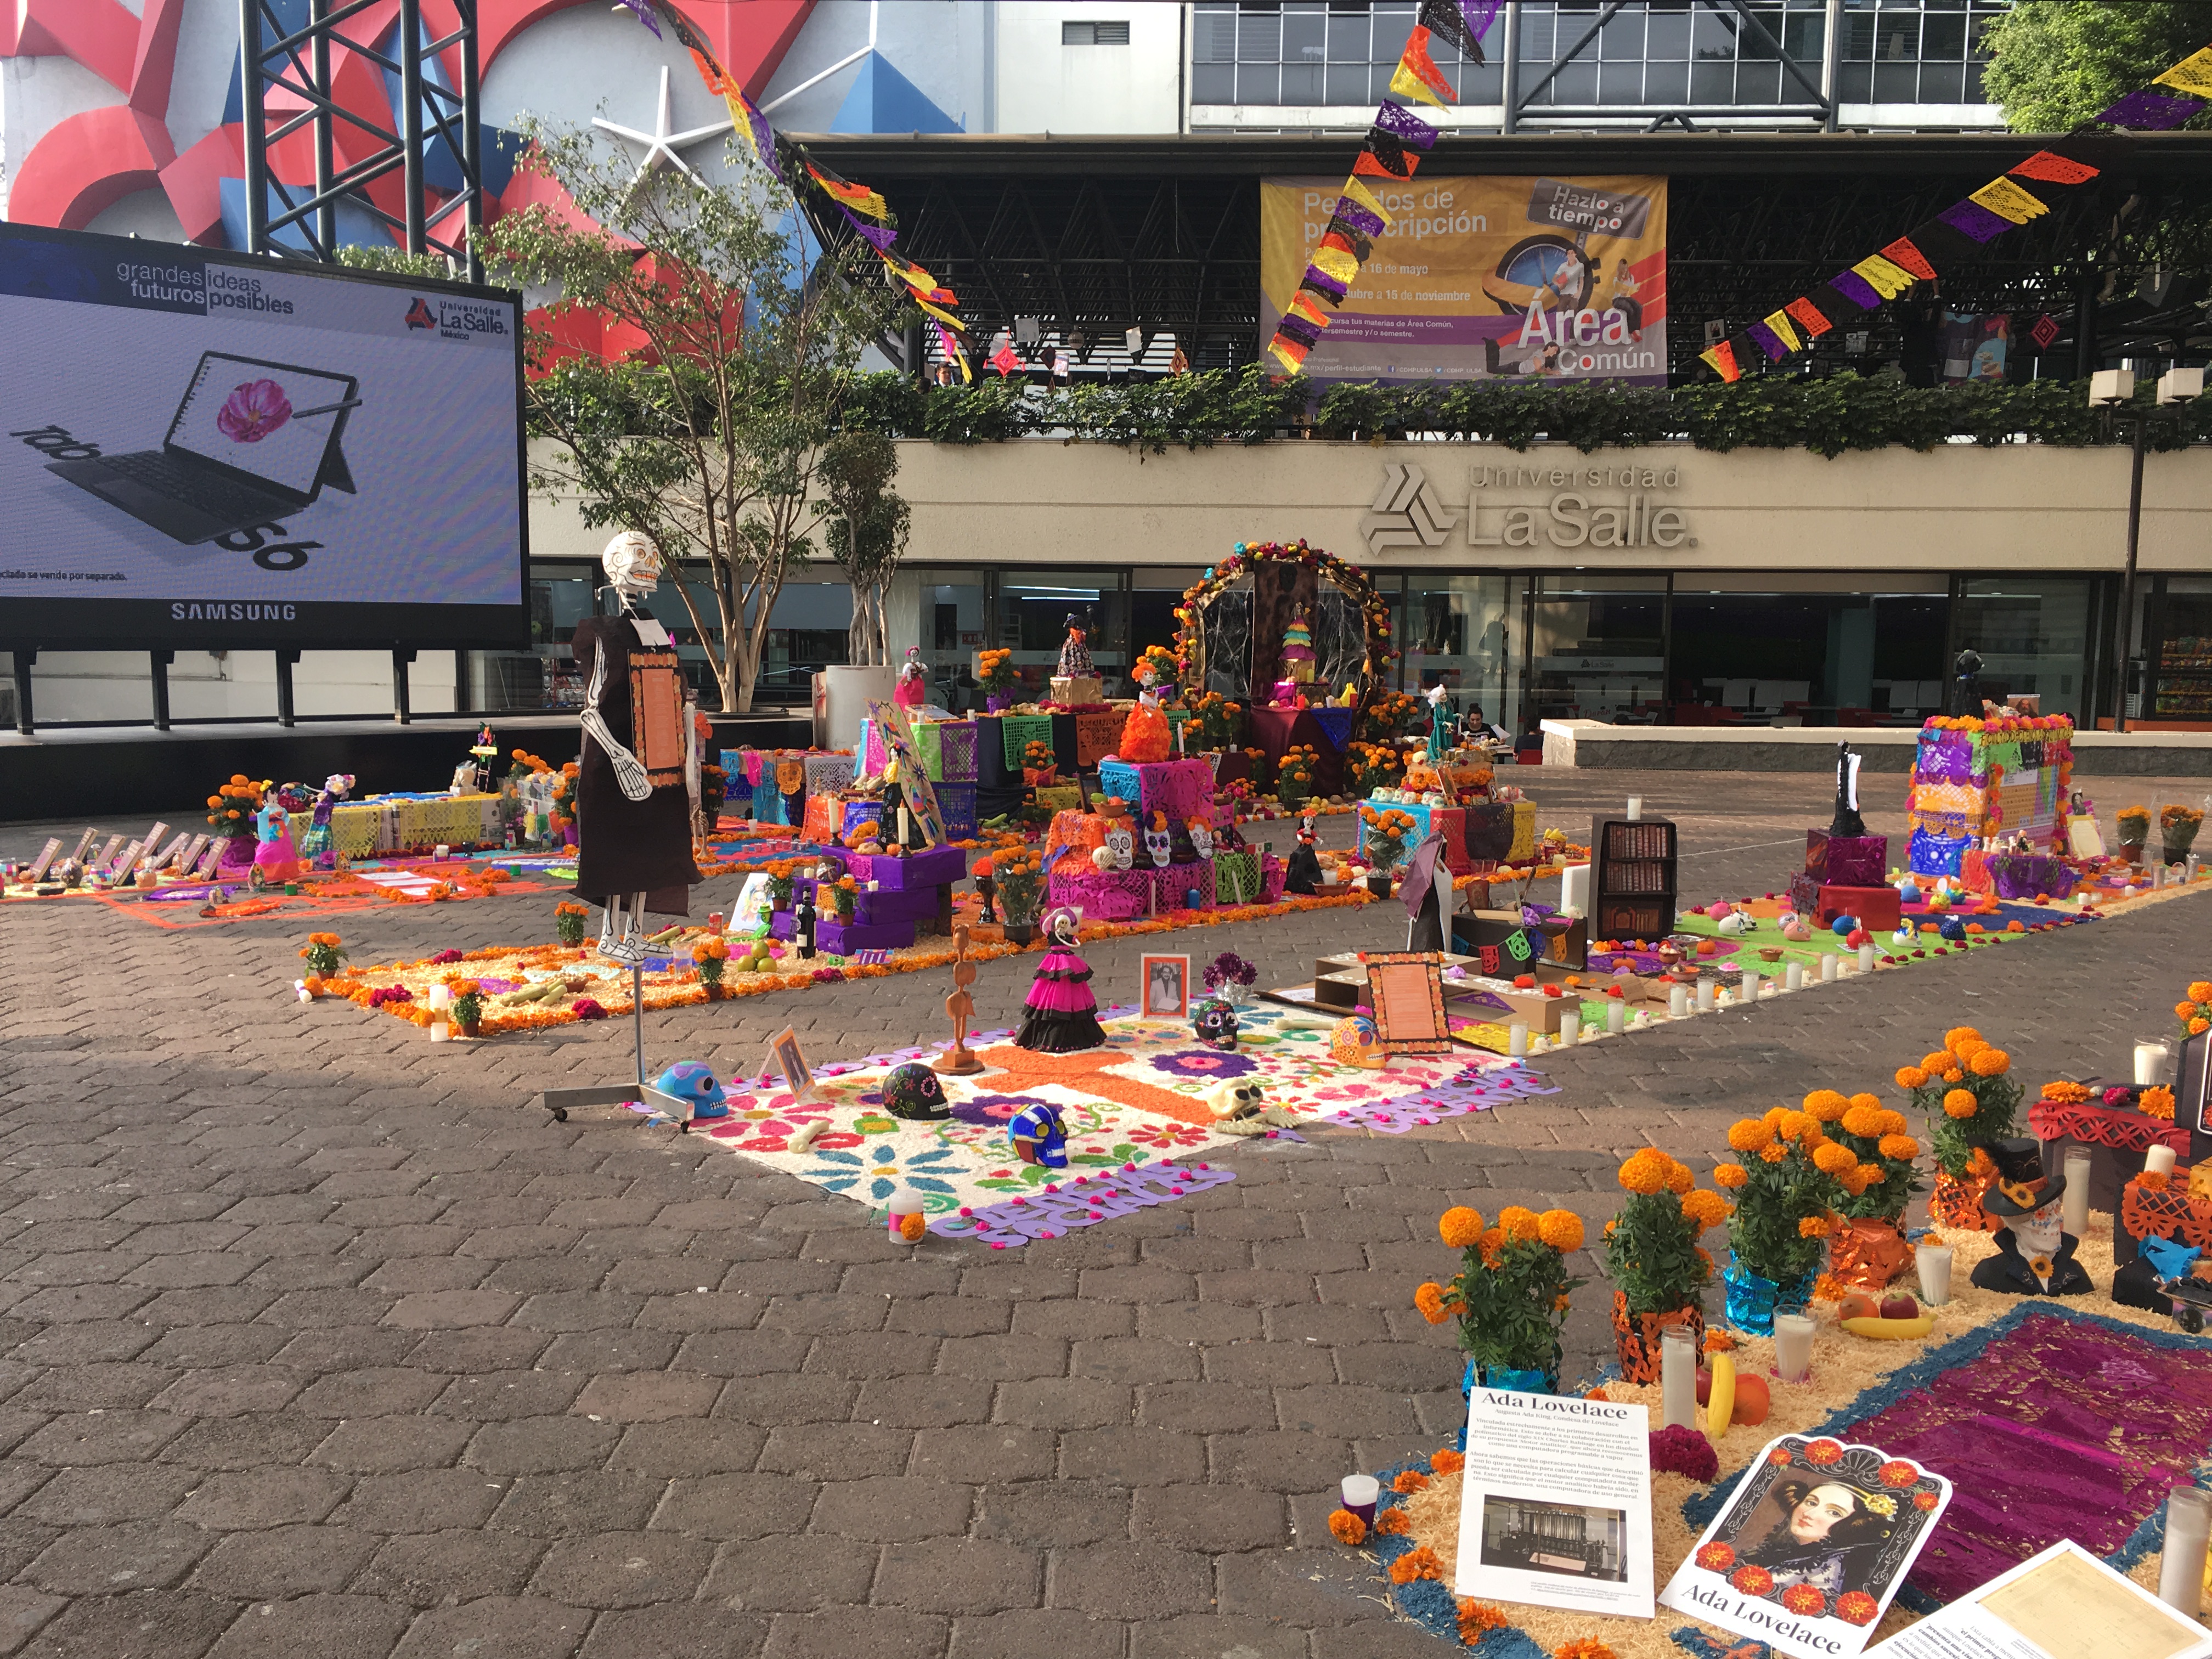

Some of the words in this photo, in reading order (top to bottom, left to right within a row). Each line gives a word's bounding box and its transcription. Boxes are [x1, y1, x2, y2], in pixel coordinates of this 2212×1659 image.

[1424, 187, 1453, 210] de
[1554, 186, 1609, 210] Hazlo
[1613, 201, 1624, 214] a
[1549, 203, 1622, 232] tiempo
[117, 263, 202, 286] grandes
[207, 269, 262, 292] ideas
[1370, 264, 1382, 273] 16
[1385, 263, 1397, 274] de
[1400, 264, 1428, 276] mayo
[131, 279, 205, 304] futuros
[209, 292, 294, 314] posibles
[1376, 291, 1383, 299] a
[1386, 290, 1397, 300] 15
[1401, 289, 1413, 300] de
[1415, 290, 1470, 301] noviembre
[440, 301, 501, 316] Universidad
[1517, 289, 1632, 348] Área
[441, 329, 469, 340] México
[1407, 319, 1424, 328] Área
[1425, 320, 1454, 329] Común,
[1558, 347, 1655, 371] Común
[1469, 464, 1680, 487] Universidad
[1469, 494, 1538, 546] La
[171, 603, 296, 620] SAMSUNG
[930, 1160, 1191, 1238] CIENCIAS
[977, 1169, 1237, 1248] SOCIALES
[1481, 1392, 1523, 1408] Ada
[1532, 1397, 1627, 1419] Lovelace
[1506, 1422, 1551, 1431] estrechamente
[1571, 1435, 1611, 1443] colaboración
[1560, 1449, 1600, 1458] programable
[1549, 1485, 1591, 1494] computadora
[1680, 1584, 1729, 1612] Ada
[1732, 1601, 1841, 1654] Lovelace
[1911, 1634, 1934, 1650] medida
[1916, 1628, 1942, 1646] cambios
[1940, 1626, 1965, 1643] aunque
[1960, 1641, 1986, 1658] Lovelace
[1965, 1634, 1988, 1650] primer
